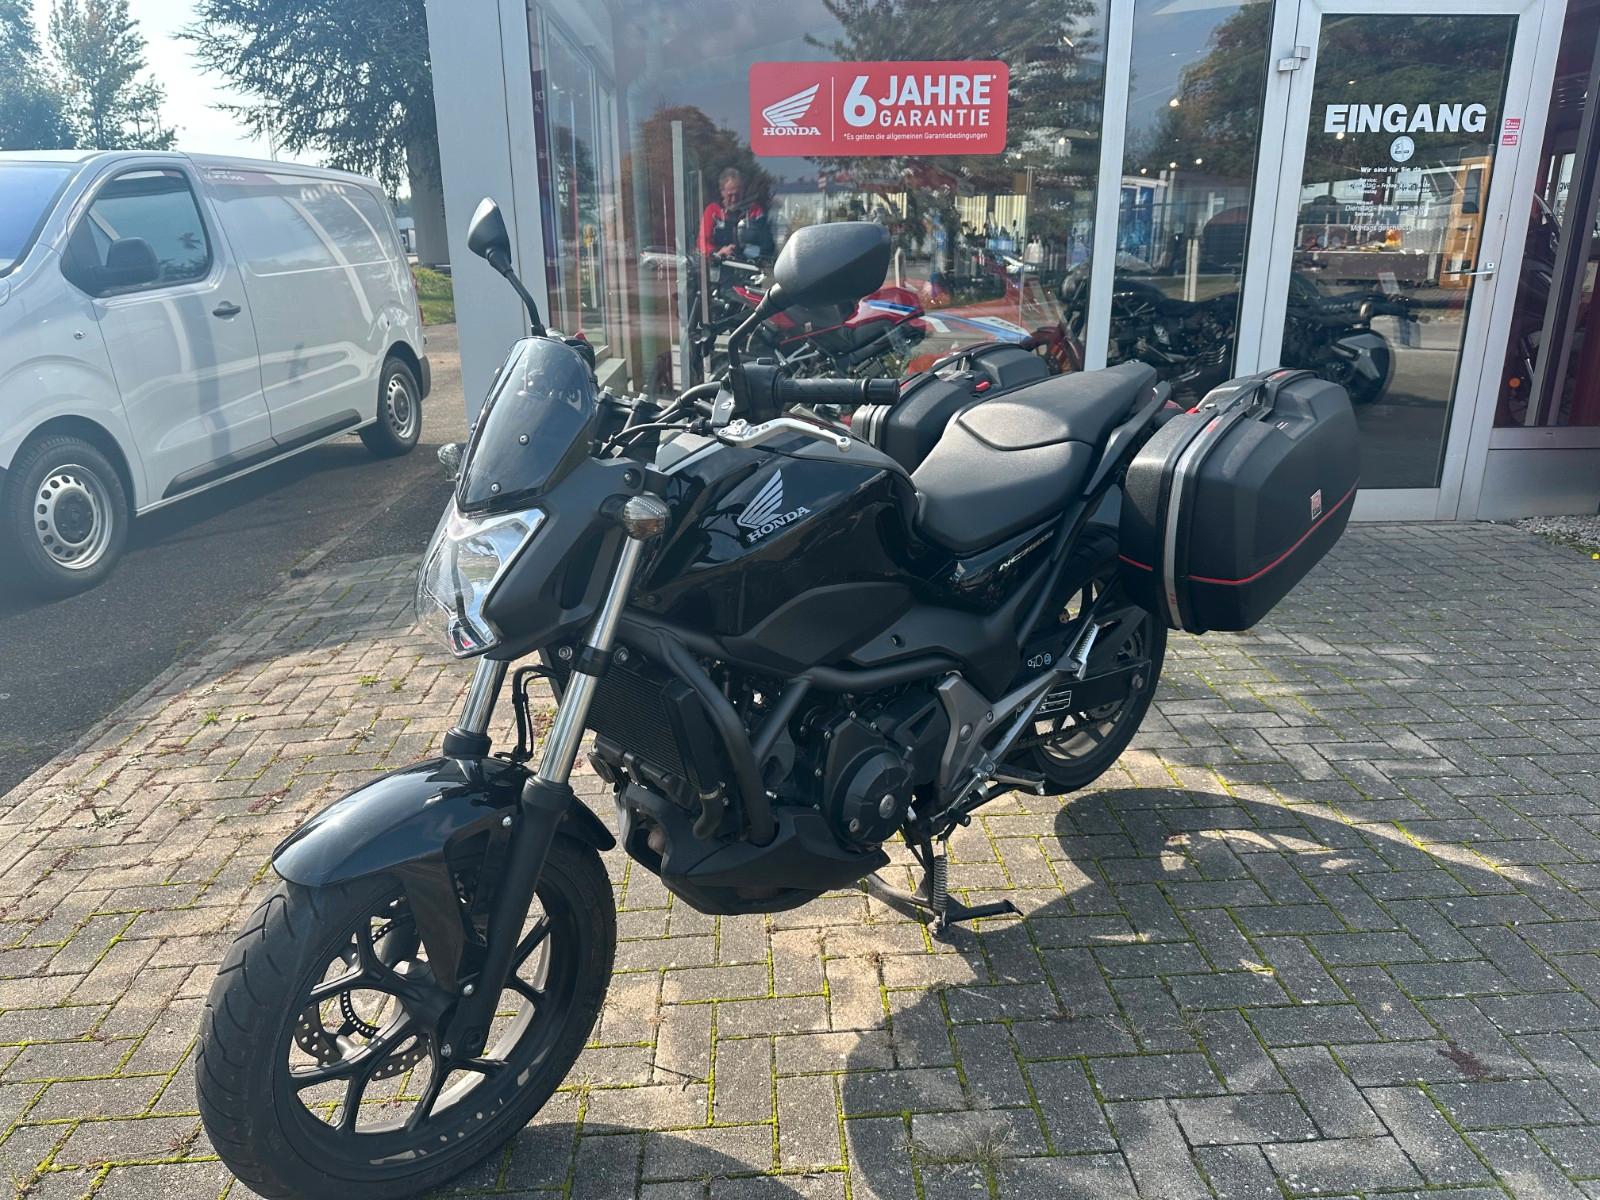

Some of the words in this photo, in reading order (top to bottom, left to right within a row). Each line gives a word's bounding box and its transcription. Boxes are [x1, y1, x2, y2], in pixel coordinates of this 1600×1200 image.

[843, 75, 877, 127] 6
[879, 109, 990, 127] GARANTIE
[1323, 103, 1487, 133] EINGANG
[763, 126, 822, 136] HONDA
[855, 133, 875, 141] gelten
[876, 132, 885, 140] die
[886, 132, 923, 141] allgemeinen
[924, 131, 988, 141] Garantiebedingungen
[746, 506, 811, 542] HONDA
